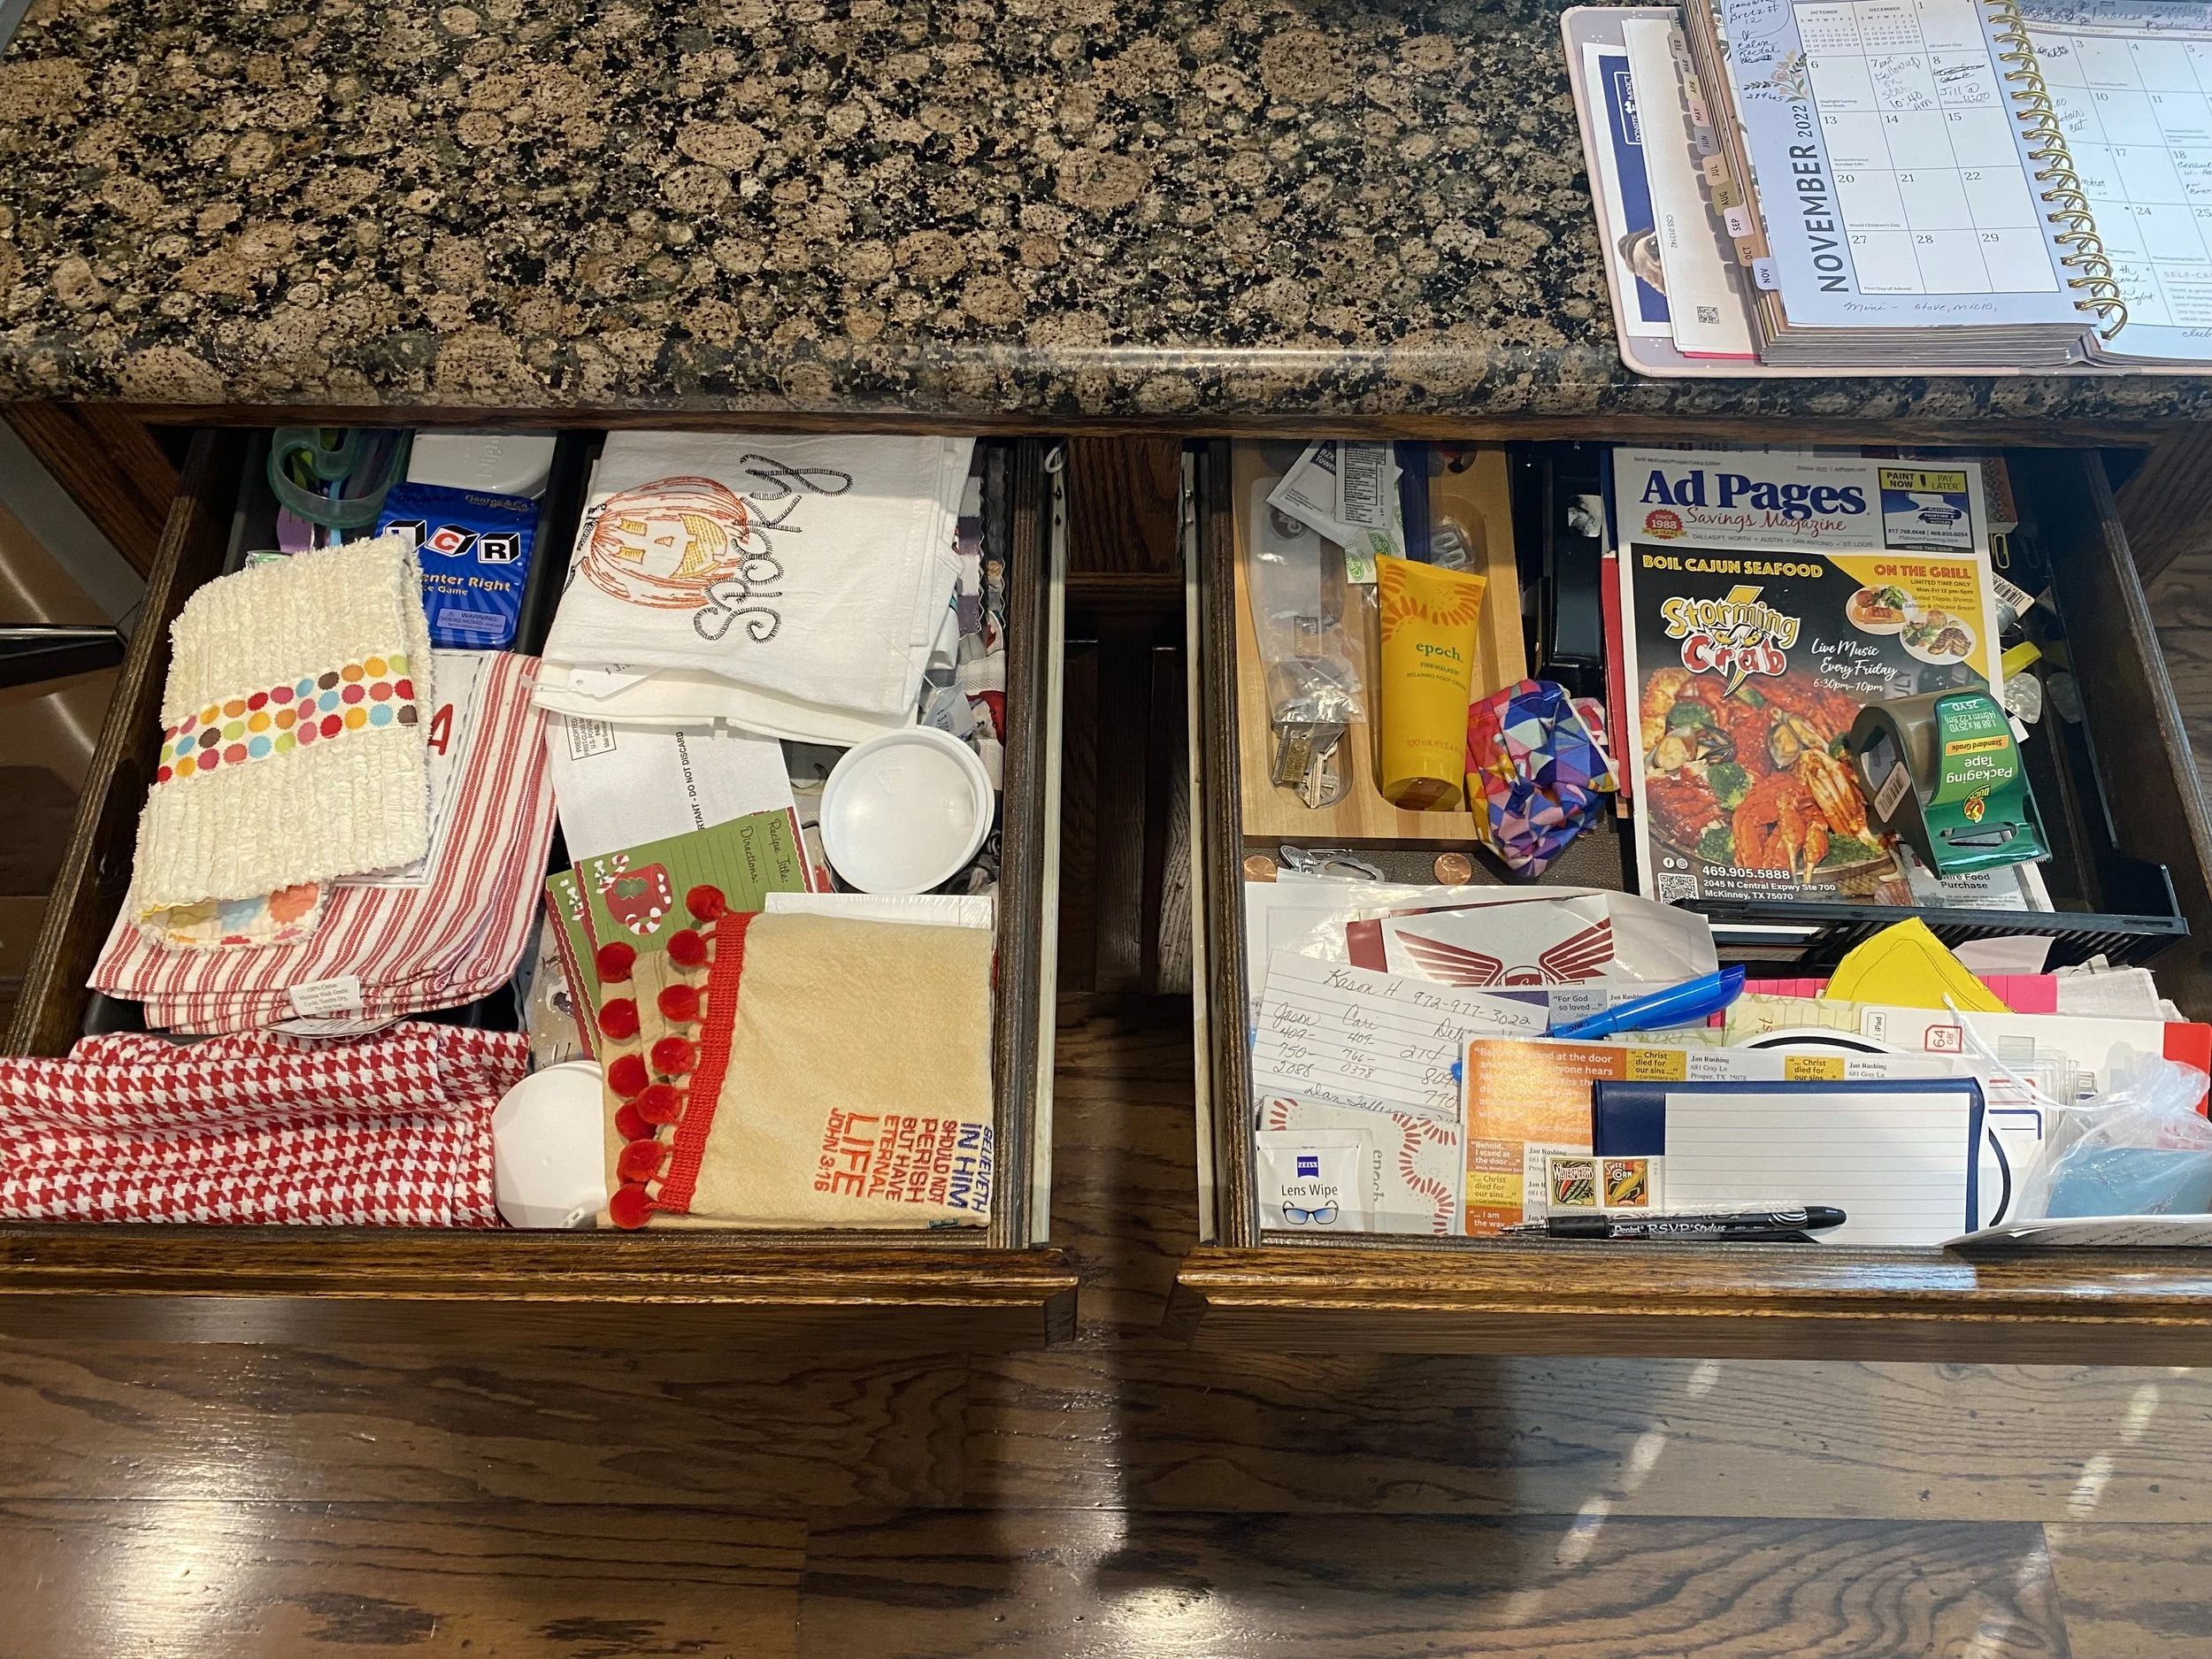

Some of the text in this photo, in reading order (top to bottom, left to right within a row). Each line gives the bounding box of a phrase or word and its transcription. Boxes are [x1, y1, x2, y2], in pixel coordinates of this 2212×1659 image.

[2096, 92, 2108, 102] 10
[1824, 115, 1838, 125] 13
[1886, 115, 1899, 124] 14
[1948, 112, 1962, 121] 15
[1701, 135, 1709, 149] JUN
[2173, 150, 2187, 159] 18
[1838, 174, 1855, 183] 20
[1901, 173, 1915, 182] 21
[1964, 172, 1981, 180] 22
[1788, 104, 1849, 292] NOVEMBER 2022
[2136, 207, 2152, 216] 24
[1732, 218, 1741, 231] SEP
[1852, 234, 1867, 244] 27
[1916, 234, 1933, 244] 28
[1982, 233, 2000, 242] 29
[1887, 472, 1915, 480] PAINT
[1640, 470, 1867, 522] Ad Pages
[1651, 520, 1677, 529] 1988
[1685, 506, 1847, 538] Savings Magazine
[1642, 555, 1824, 578] BOIL CAJUN SEAFOOD
[1874, 565, 1972, 580] ON THE GRILL
[438, 587, 468, 596] Game
[468, 577, 511, 592] Right
[1663, 597, 1800, 648] Storming
[1416, 642, 1460, 663] epoch
[1682, 634, 1787, 676] Crab
[1811, 638, 1879, 657] Live Music
[1420, 662, 1459, 675] FIREWALKER
[1820, 657, 1899, 682] Every Friday
[571, 718, 583, 753] PRESORTED
[1973, 739, 2002, 749] Standard
[675, 731, 697, 797] DO NOT DISCARD
[1964, 756, 1995, 767] Tape
[1947, 767, 2013, 784] Packaging
[740, 826, 758, 884] Directions:
[767, 818, 791, 883] Recipe Title:
[1701, 864, 1791, 880] 469.905.5888
[1737, 880, 1770, 890] Central
[1770, 882, 1801, 892] Expwy
[1705, 889, 1751, 900] McKinney,
[1766, 892, 1793, 901] 75070
[1384, 979, 1403, 996] H
[1933, 1029, 1946, 1048] 64
[1569, 1053, 1586, 1062] the
[1588, 1054, 1613, 1064] door
[1585, 1066, 1613, 1076] hears
[813, 1107, 846, 1192] JOHN 3:16
[933, 1119, 958, 1174] SHOULD
[831, 1112, 879, 1198] LIFE
[867, 1114, 901, 1198] ETERNAL
[886, 1117, 918, 1202] BUT HAVE
[904, 1118, 939, 1203] PERISH
[948, 1123, 982, 1209] IN HIM
[971, 1127, 994, 1213] BELIEVETH
[1552, 1162, 1594, 1180] WATERMELONS
[1604, 1162, 1626, 1178] SWEET
[1612, 1169, 1632, 1180] CORN
[927, 1177, 947, 1205] NOT
[1281, 1184, 1338, 1198] Lens Wipe
[1614, 1225, 1641, 1234] Pentel
[1694, 1223, 1726, 1233] Stylus
